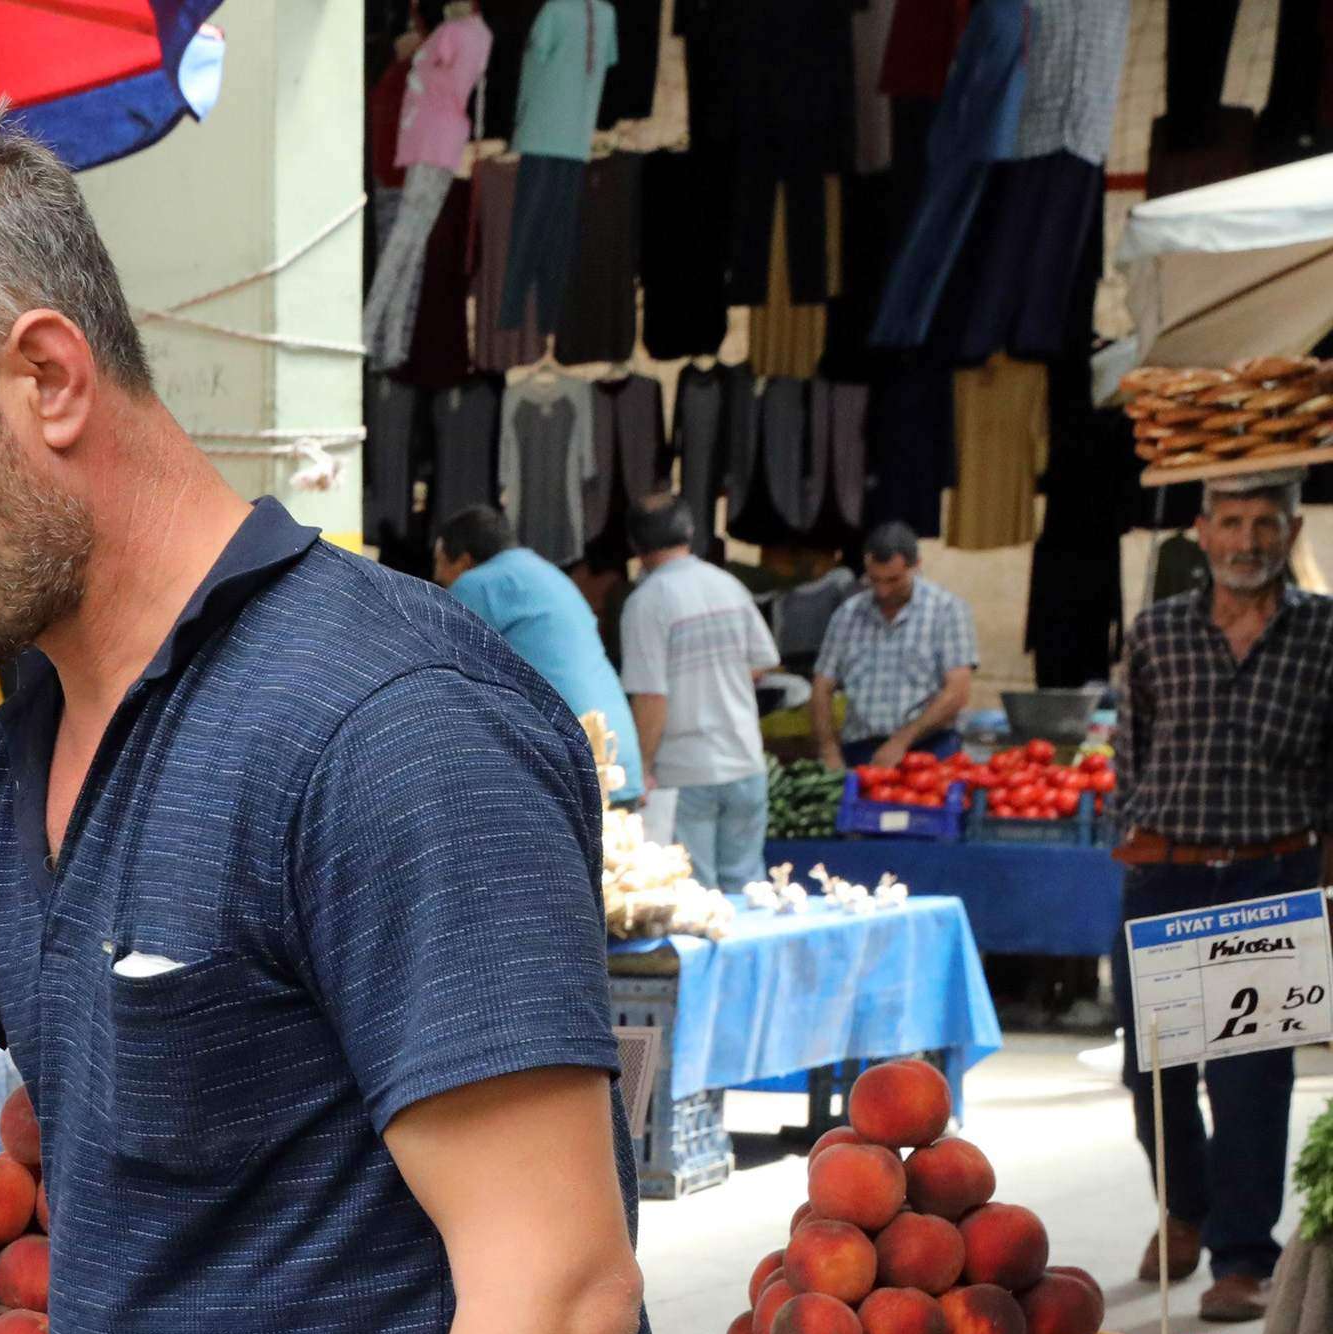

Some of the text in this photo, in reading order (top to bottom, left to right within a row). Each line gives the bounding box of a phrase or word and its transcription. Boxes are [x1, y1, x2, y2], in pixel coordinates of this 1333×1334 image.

[1165, 901, 1289, 937] FİYAT ETİKETİ
[1208, 985, 1325, 1044] 2 50
